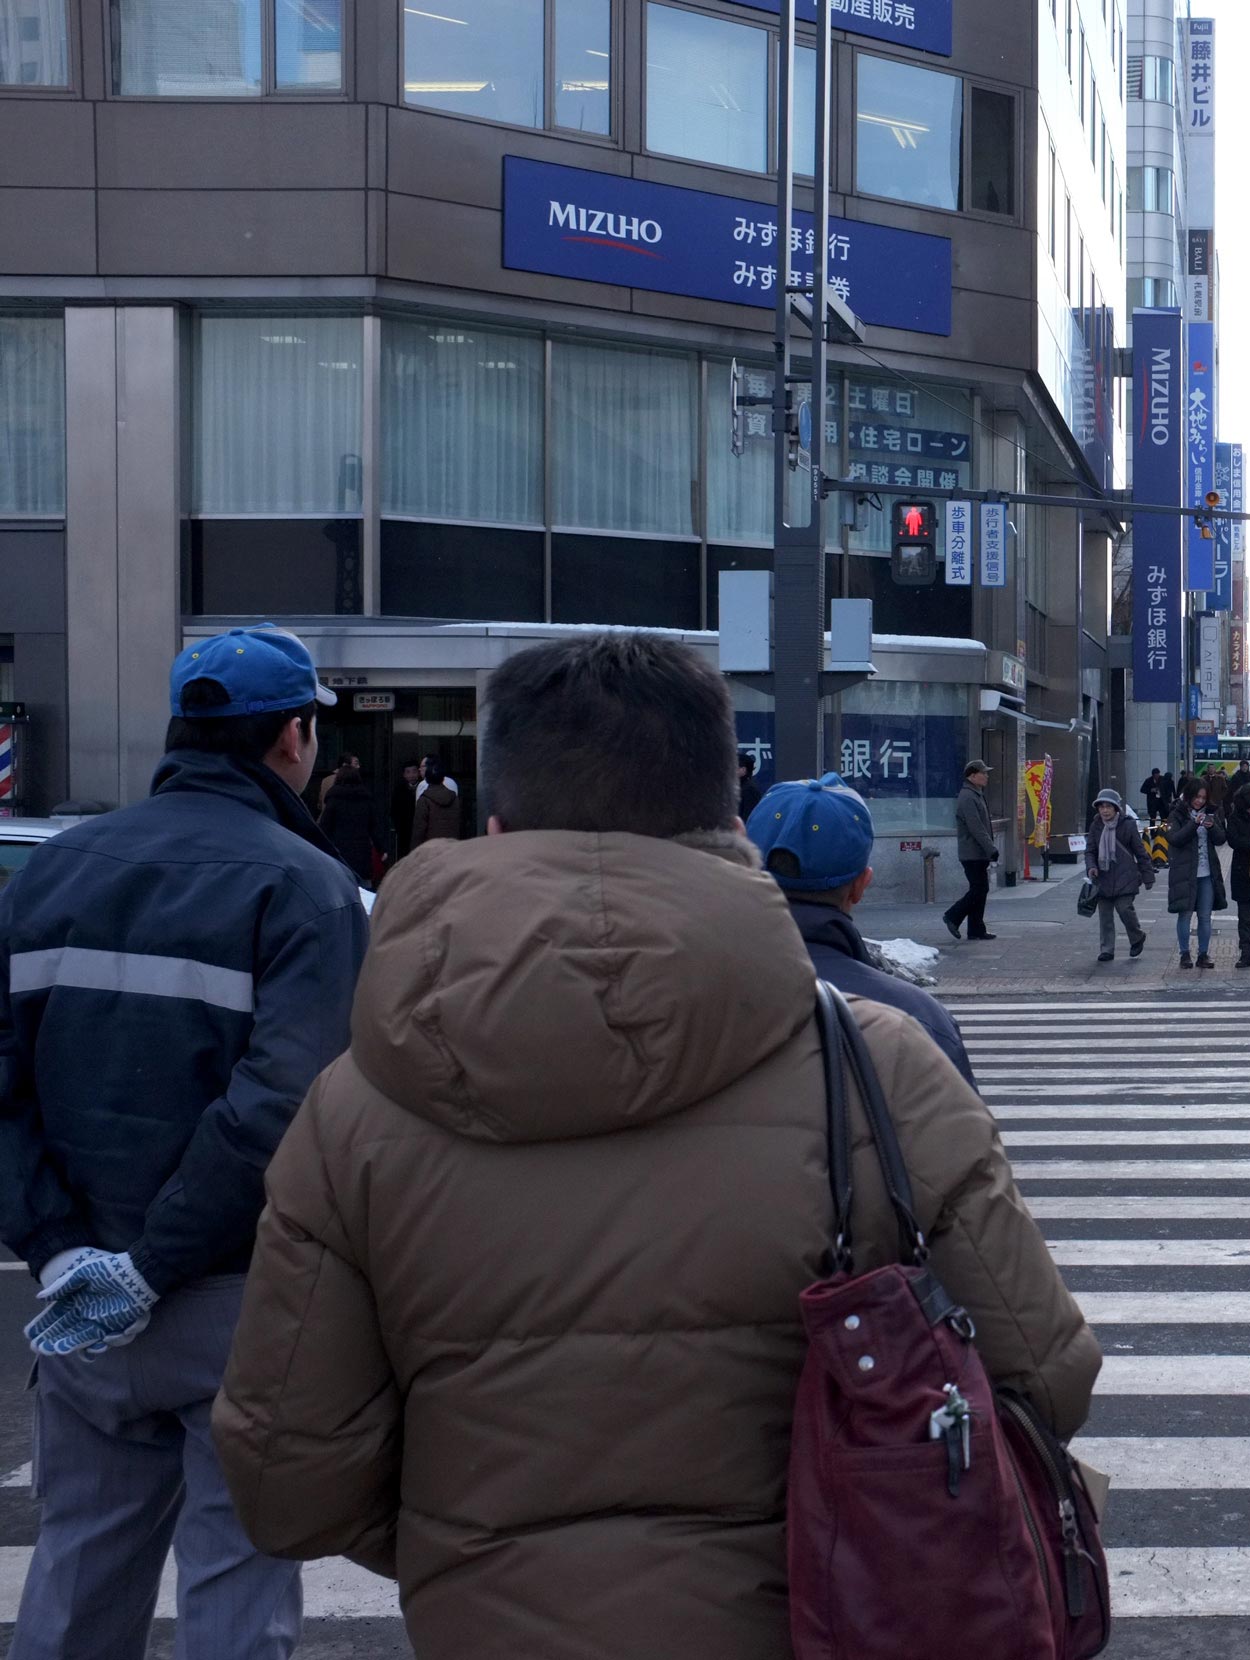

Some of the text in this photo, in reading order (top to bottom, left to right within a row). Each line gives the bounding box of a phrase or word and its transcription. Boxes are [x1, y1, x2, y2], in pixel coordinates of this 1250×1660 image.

[813, 0, 915, 30] 動産販売
[1191, 41, 1211, 127] 藤井ビル
[549, 201, 663, 244] MIZUHO
[1151, 348, 1170, 446] MIZUHO
[1232, 448, 1242, 513] おしま信用金
[952, 506, 965, 580] 歩車分離式
[985, 508, 999, 583] 歩行者支援信号
[1147, 566, 1167, 670] みずほ銀行
[1232, 631, 1241, 671] カラオケ
